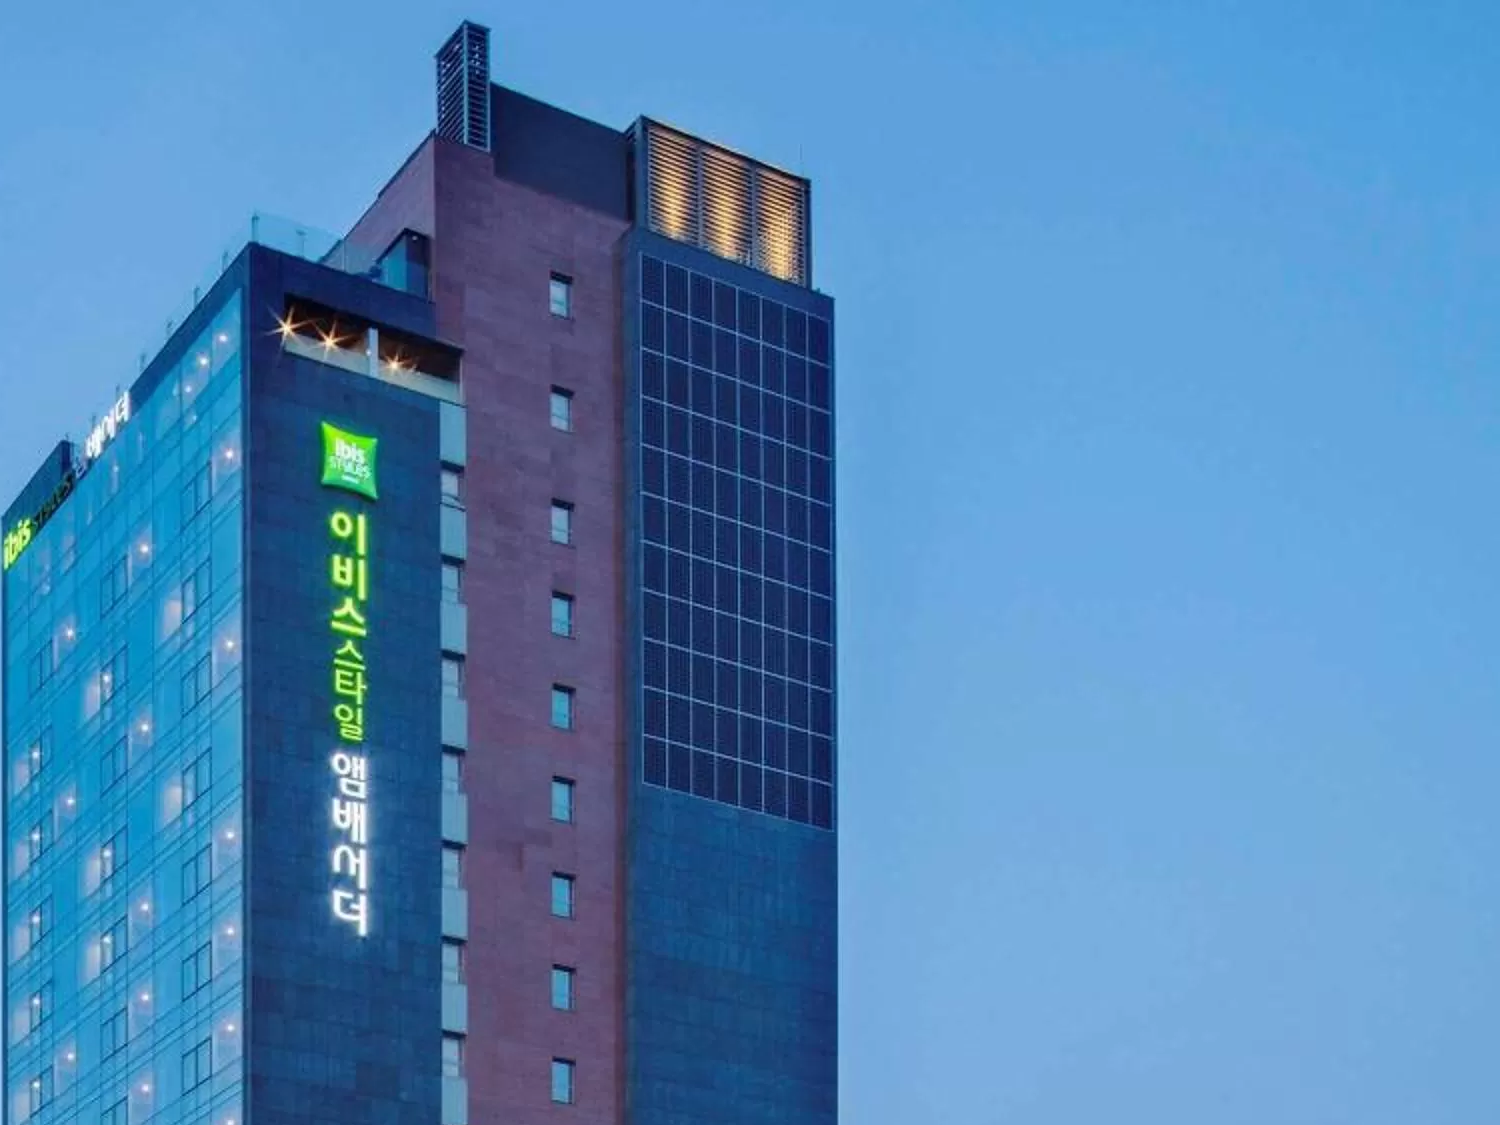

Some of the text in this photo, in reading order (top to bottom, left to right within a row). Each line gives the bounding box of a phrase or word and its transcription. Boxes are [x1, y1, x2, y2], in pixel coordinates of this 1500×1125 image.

[335, 438, 365, 464] ibis
[3, 517, 32, 570] ibis
[330, 511, 367, 637] 이비스
[333, 639, 367, 742] 스타일
[331, 752, 367, 937] 앰배서더
